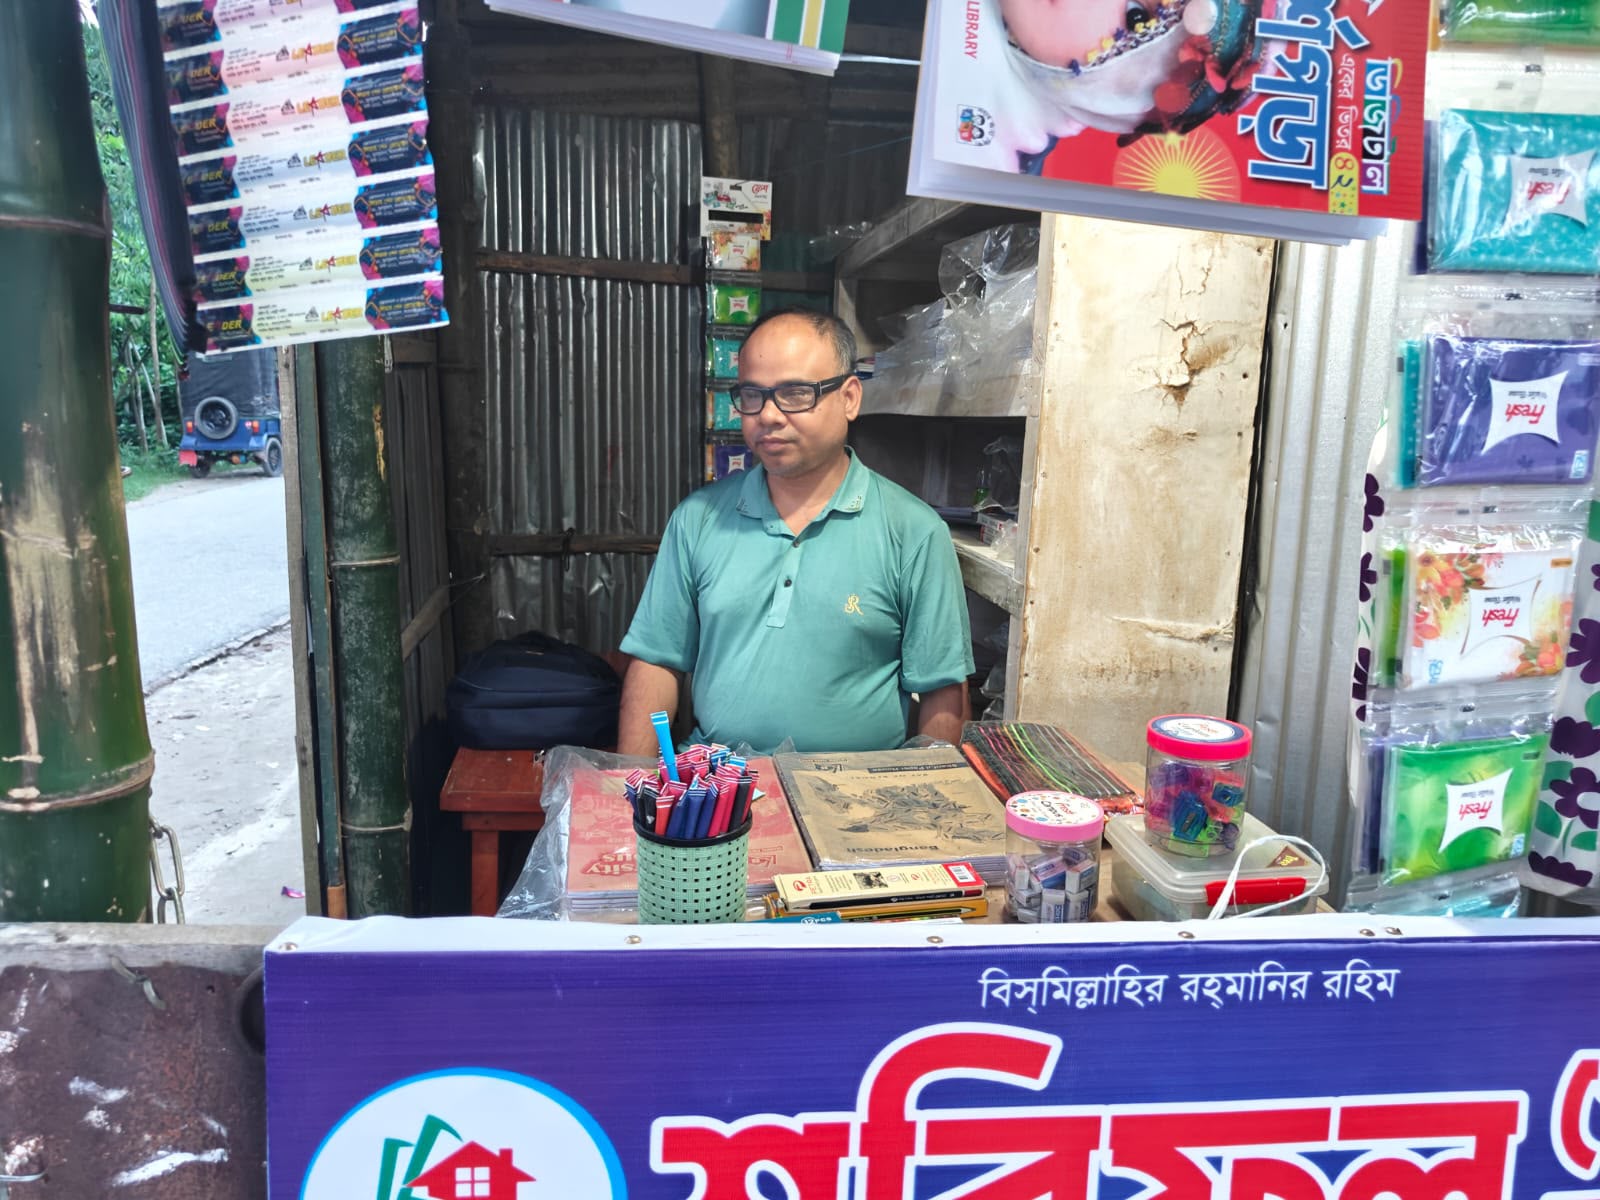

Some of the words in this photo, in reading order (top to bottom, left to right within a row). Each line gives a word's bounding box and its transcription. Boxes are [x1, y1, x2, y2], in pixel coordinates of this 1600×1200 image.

[964, 0, 980, 60] LIBRARY
[1337, 53, 1357, 99] একের
[1335, 105, 1358, 149] ভিতর
[1504, 403, 1546, 425] Fresh
[1482, 608, 1520, 627] Fresh
[1459, 800, 1493, 821] Fresh
[846, 845, 940, 854] Bangladesh
[1322, 958, 1400, 1001] রহিম
